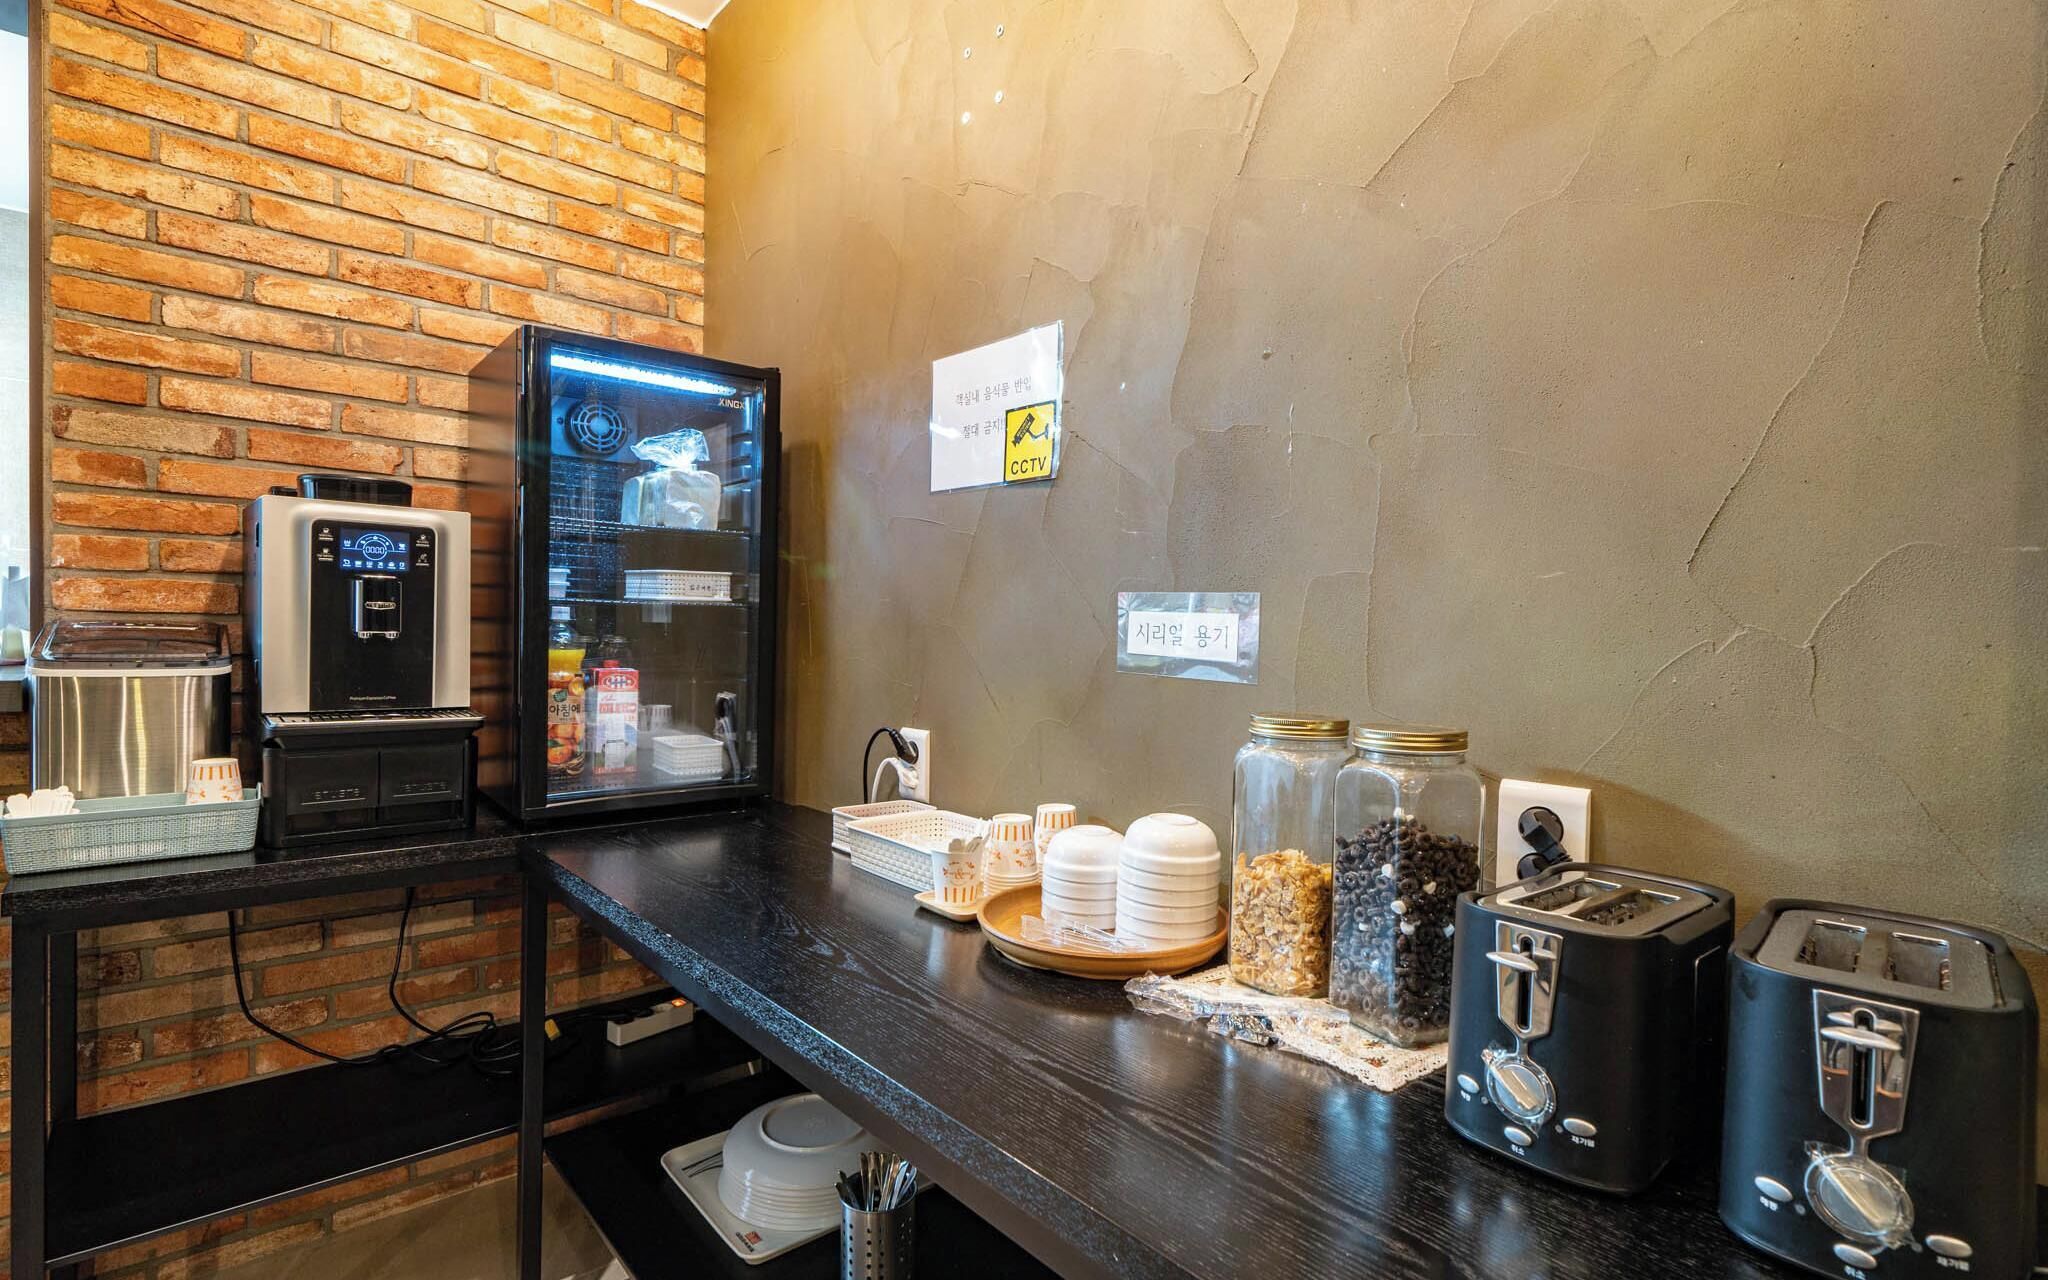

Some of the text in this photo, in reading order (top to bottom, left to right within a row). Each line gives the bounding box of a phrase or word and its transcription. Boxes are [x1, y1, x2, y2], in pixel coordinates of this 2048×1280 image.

[984, 382, 1009, 401] 음식물
[1014, 376, 1032, 394] 반입
[1010, 456, 1047, 476] CCTV
[1193, 624, 1229, 649] 용기
[549, 703, 581, 717] 아침에
